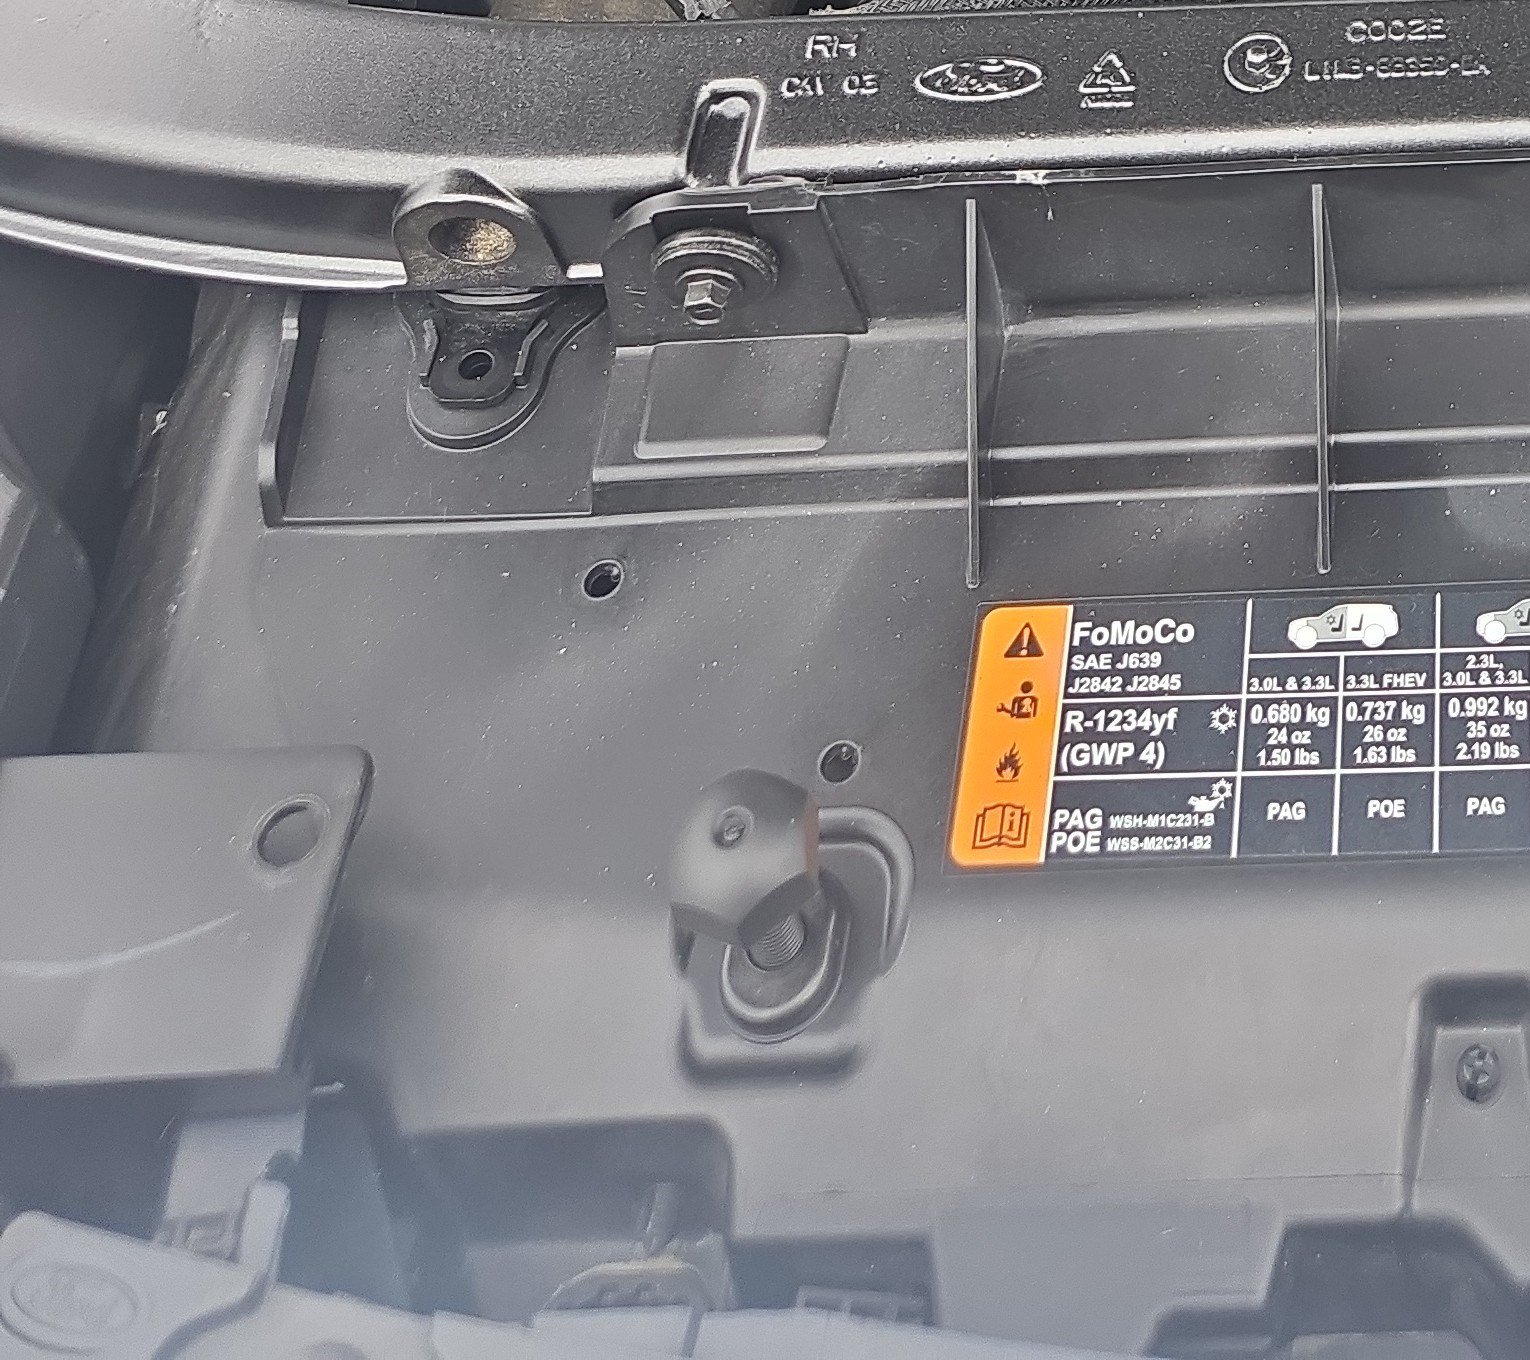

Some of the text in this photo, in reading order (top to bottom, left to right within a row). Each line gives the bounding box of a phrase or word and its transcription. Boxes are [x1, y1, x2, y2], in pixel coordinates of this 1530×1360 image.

[804, 34, 859, 59] RH
[1072, 618, 1195, 647] FoMoCo
[1070, 652, 1162, 670] SAE J639
[1466, 654, 1504, 669] 2.3L,
[1067, 674, 1182, 693] J2842 J2845
[1249, 675, 1335, 691] 3.0L & 3.3L
[1346, 673, 1427, 689] 3.3L FHEV
[1442, 670, 1529, 686] 3.0L & 3.3L
[1251, 702, 1330, 727] 0.680 kg
[1346, 700, 1425, 725] 0.737 kg
[1448, 696, 1528, 721] 0.992 kg
[1064, 708, 1179, 736] R-1234yf
[1466, 721, 1511, 738] 35 oz
[1267, 726, 1312, 744] 24 oz
[1362, 725, 1407, 742] 26 oz
[1059, 740, 1166, 772] (GWP 4)
[1257, 748, 1320, 766] 1.50 lbs
[1353, 745, 1416, 764] 1.63 lbs
[1455, 741, 1520, 760] 2.19 lbs
[1267, 801, 1306, 821] PAG
[1367, 799, 1406, 818] POE
[1466, 797, 1506, 817] PAG
[1052, 808, 1215, 830] PAG WSH-M1C231-B
[1050, 830, 1212, 853] POE WSS-M2C31-B2
